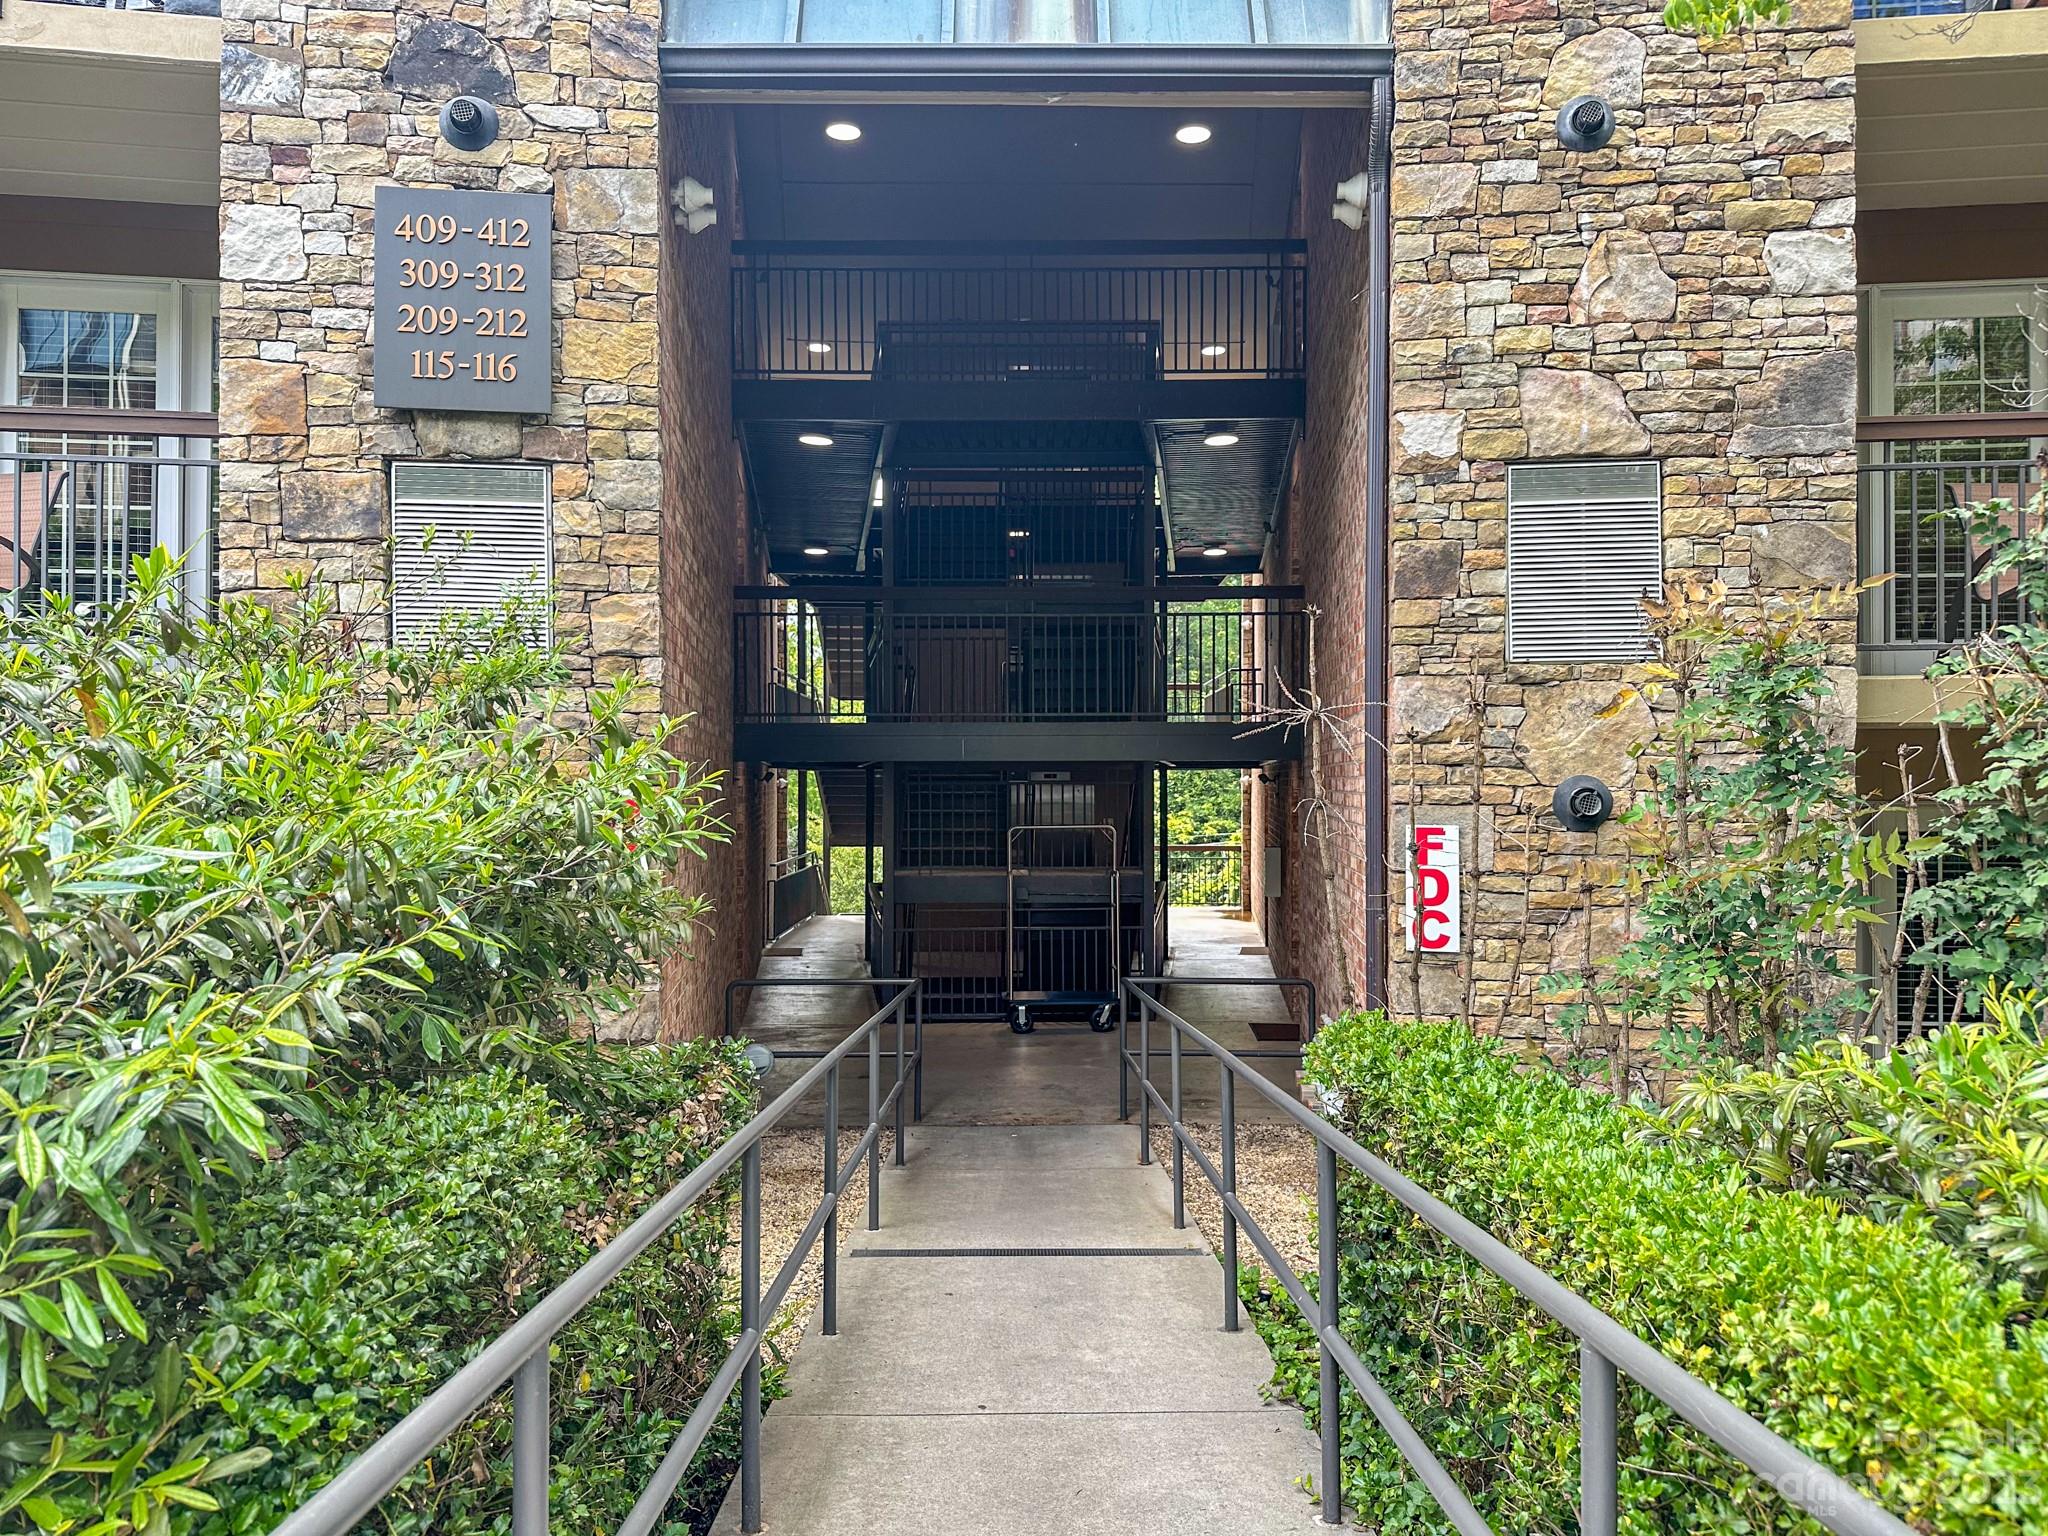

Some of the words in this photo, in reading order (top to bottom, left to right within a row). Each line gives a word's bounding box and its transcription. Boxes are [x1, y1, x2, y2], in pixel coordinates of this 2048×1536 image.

[394, 214, 531, 248] 409-412
[399, 258, 527, 293] 309-312
[396, 303, 529, 338] 209-212
[410, 349, 518, 382] 115-116
[1412, 827, 1451, 949] FDC
